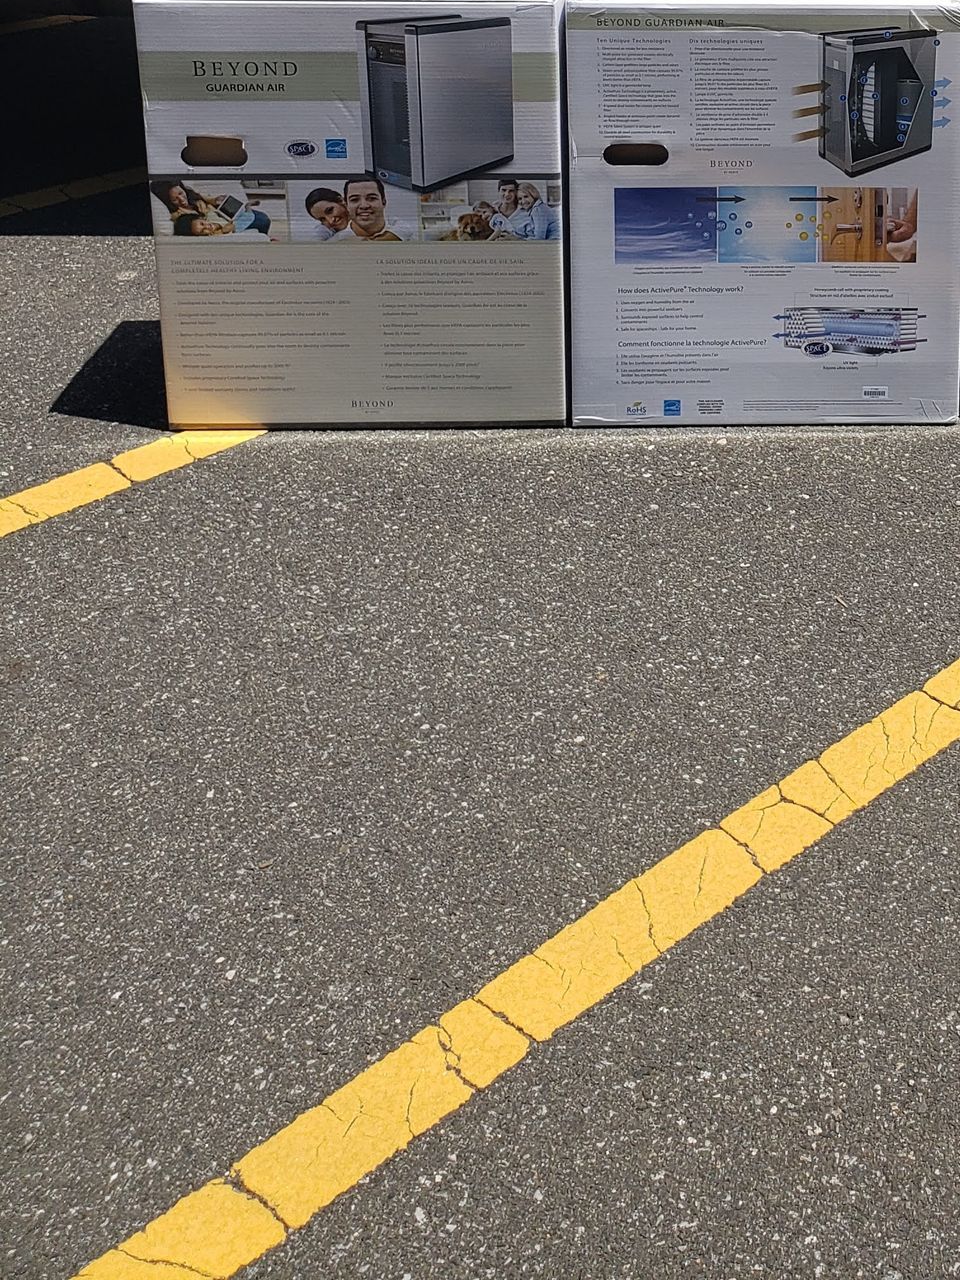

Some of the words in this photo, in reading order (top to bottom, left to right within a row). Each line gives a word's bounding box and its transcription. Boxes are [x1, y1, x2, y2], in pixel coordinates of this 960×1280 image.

[596, 18, 641, 27] BEYOND
[645, 18, 702, 27] GUARDIAN
[706, 19, 724, 27] AIR
[192, 60, 298, 76] BEYOND
[205, 83, 264, 92] GUARDIAN
[267, 83, 285, 92] AIR
[692, 339, 729, 347] technologie
[351, 400, 394, 408] BEYOND
[626, 406, 647, 414] RoHS
